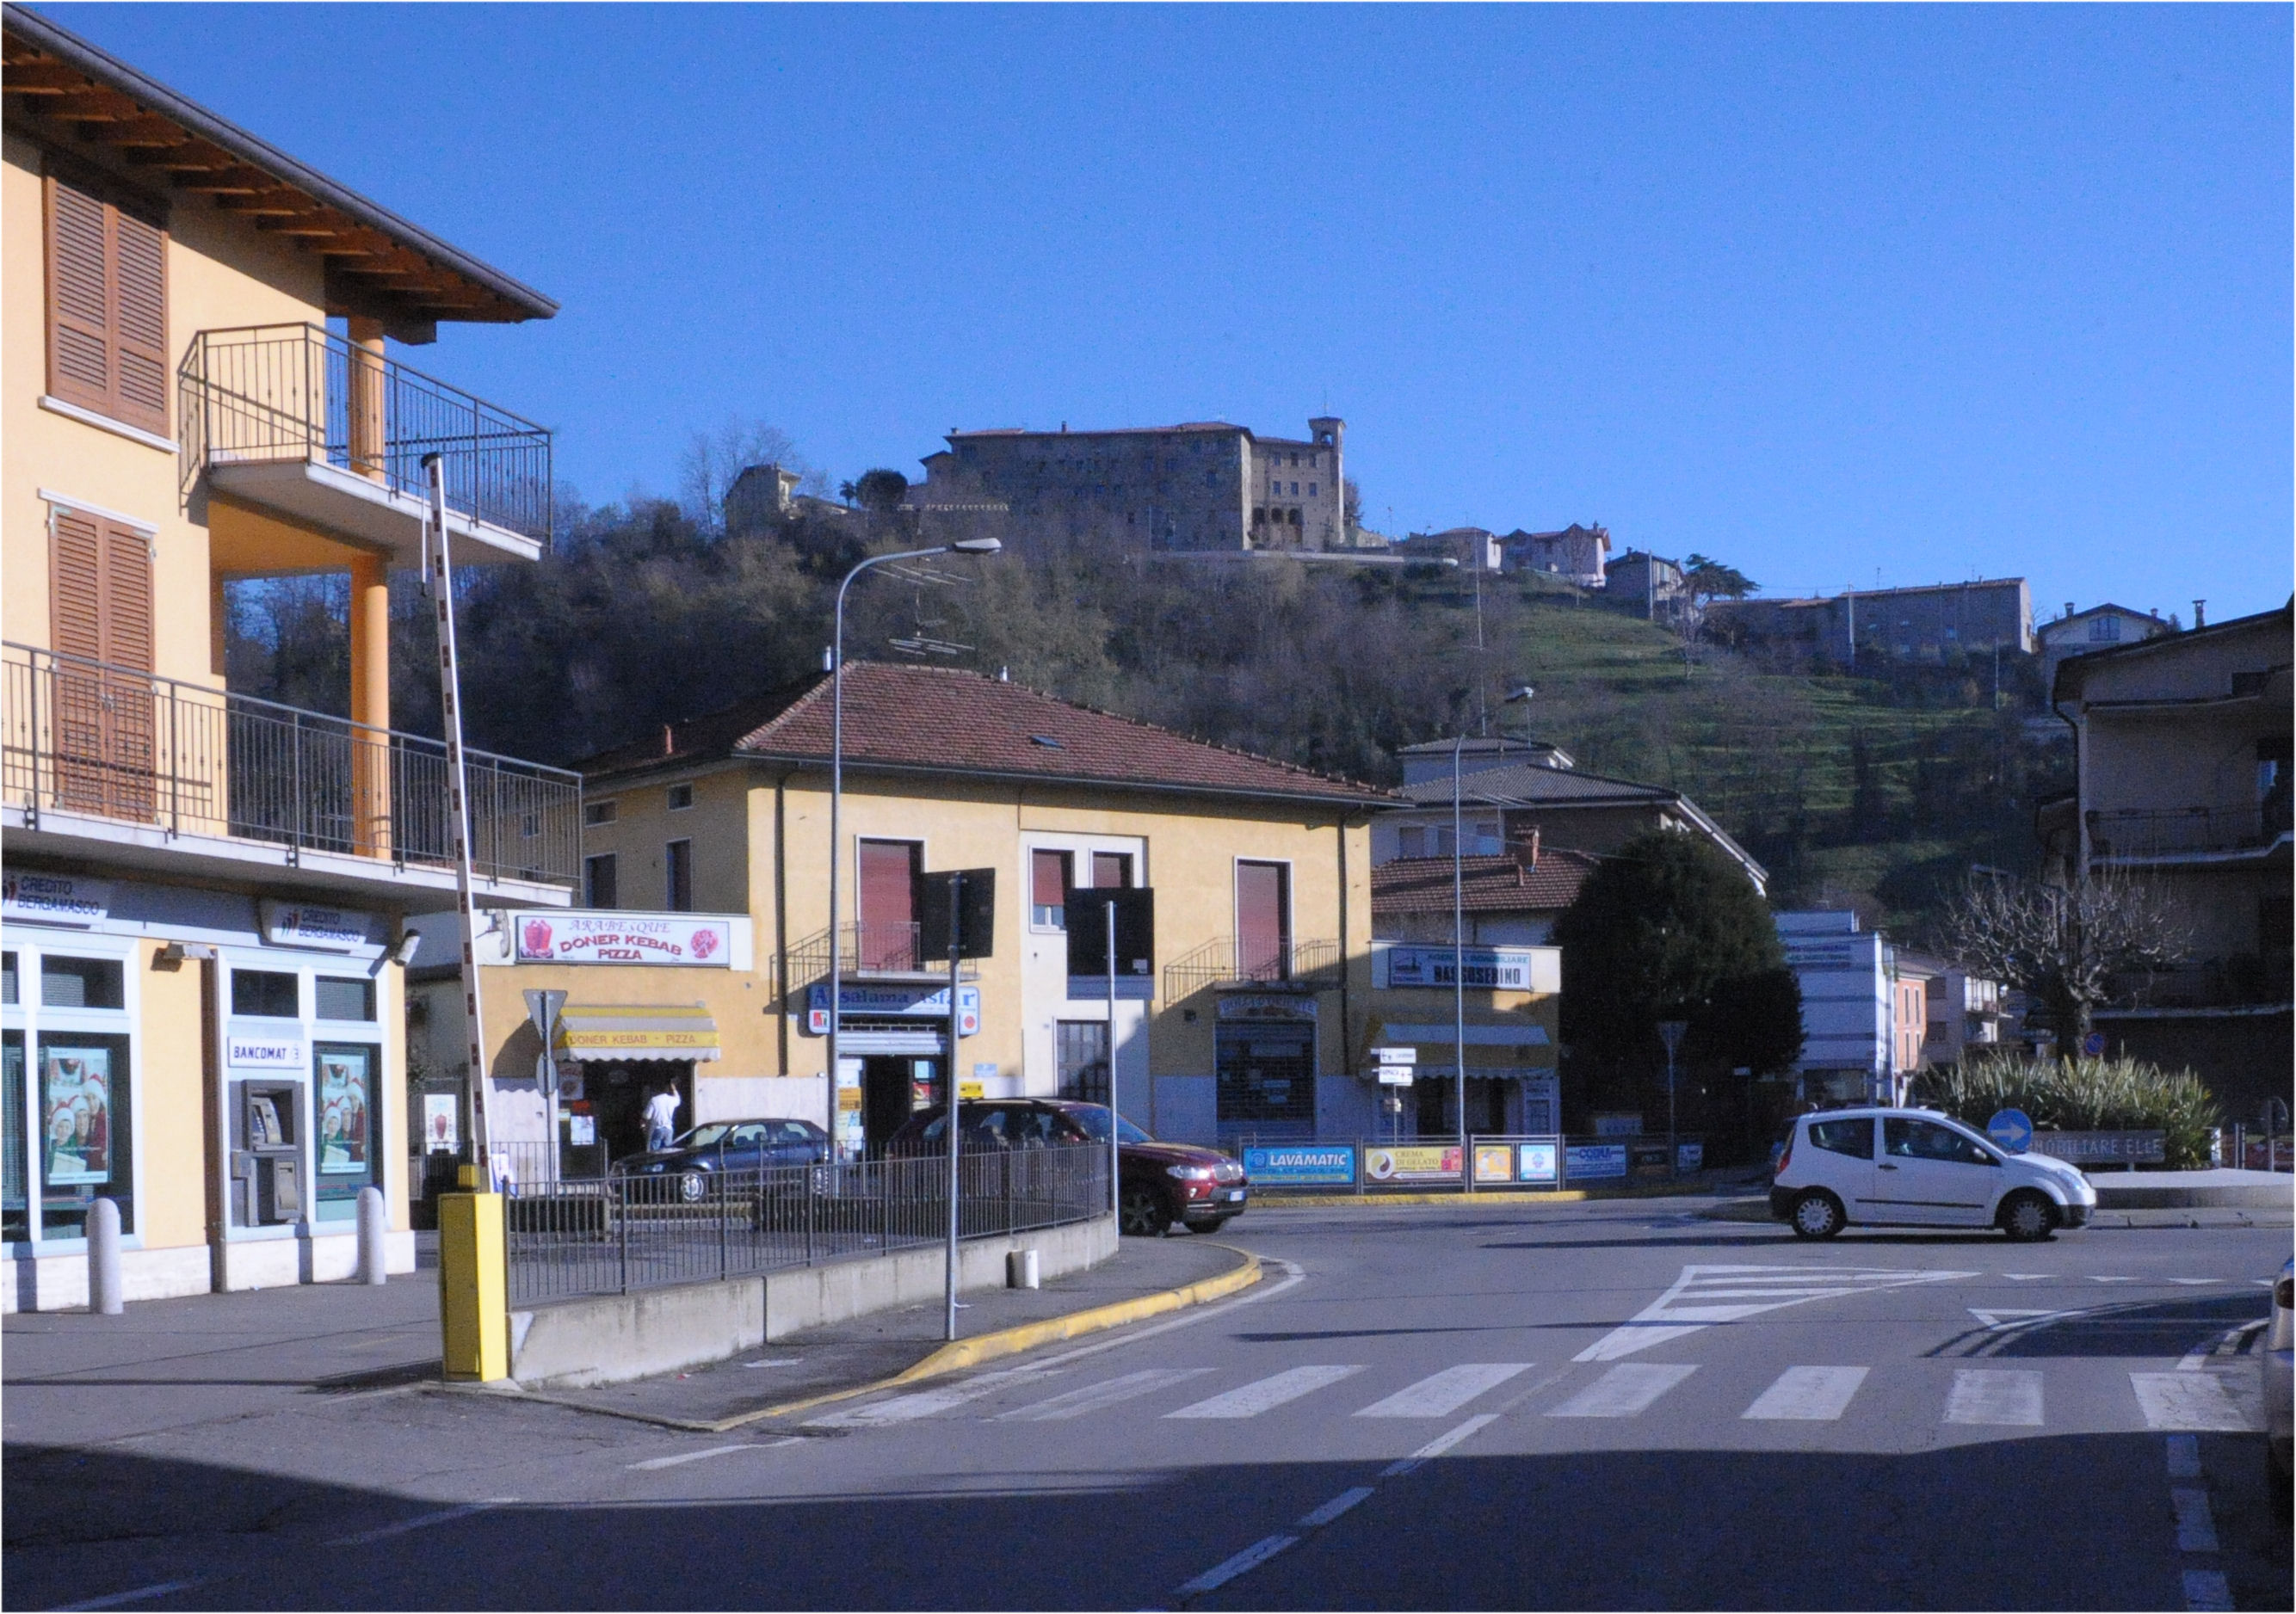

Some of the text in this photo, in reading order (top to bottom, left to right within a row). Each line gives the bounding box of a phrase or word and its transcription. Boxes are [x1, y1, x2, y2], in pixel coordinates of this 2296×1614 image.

[21, 876, 73, 895] CREDITO
[17, 894, 100, 915] BERGAMASCO
[302, 908, 341, 925] CREDITO
[298, 923, 360, 942] BERGAMASCO
[625, 934, 683, 956] KEBAB
[597, 948, 643, 960] PIZZA
[612, 1034, 648, 1044] KEBAB
[665, 1034, 696, 1044] PIZZA
[233, 1045, 287, 1060] BANCOMAT
[1269, 1154, 1348, 1167] LAVAMATIC
